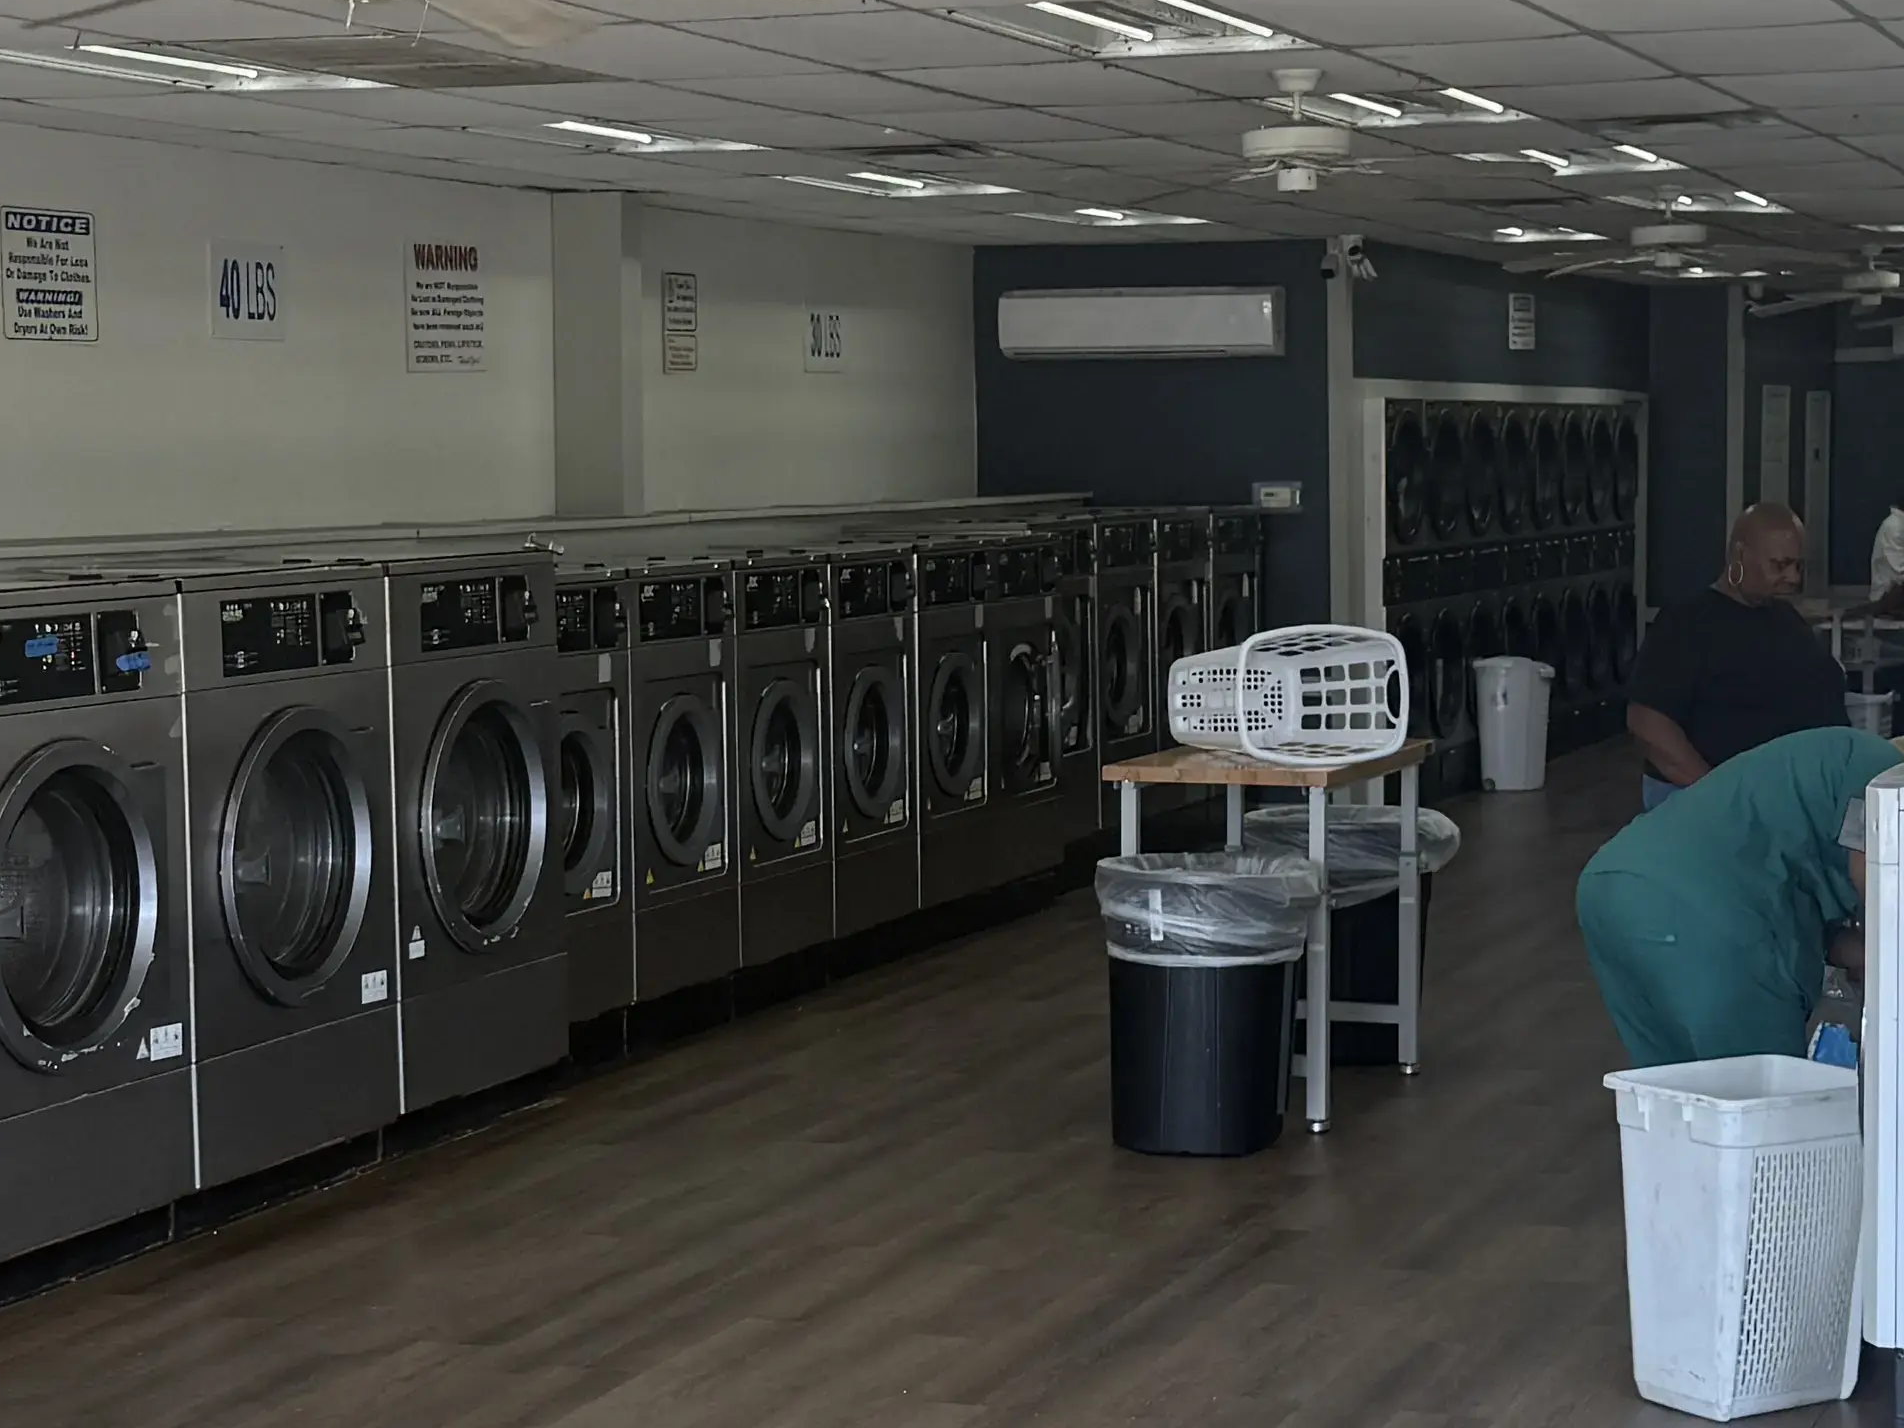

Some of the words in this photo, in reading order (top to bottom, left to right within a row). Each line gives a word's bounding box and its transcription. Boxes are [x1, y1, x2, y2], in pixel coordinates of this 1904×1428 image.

[7, 213, 89, 233] NOTICE
[39, 238, 53, 250] Are
[55, 254, 69, 266] For
[413, 243, 478, 272] WARNING
[16, 268, 47, 283] Damage
[48, 270, 59, 282] To
[18, 290, 80, 303] WARNING!
[220, 258, 240, 320] 40
[246, 261, 276, 322] LBS
[17, 306, 32, 318] Use
[34, 307, 66, 319] Washers
[67, 309, 83, 319] And
[824, 315, 842, 359] LBS
